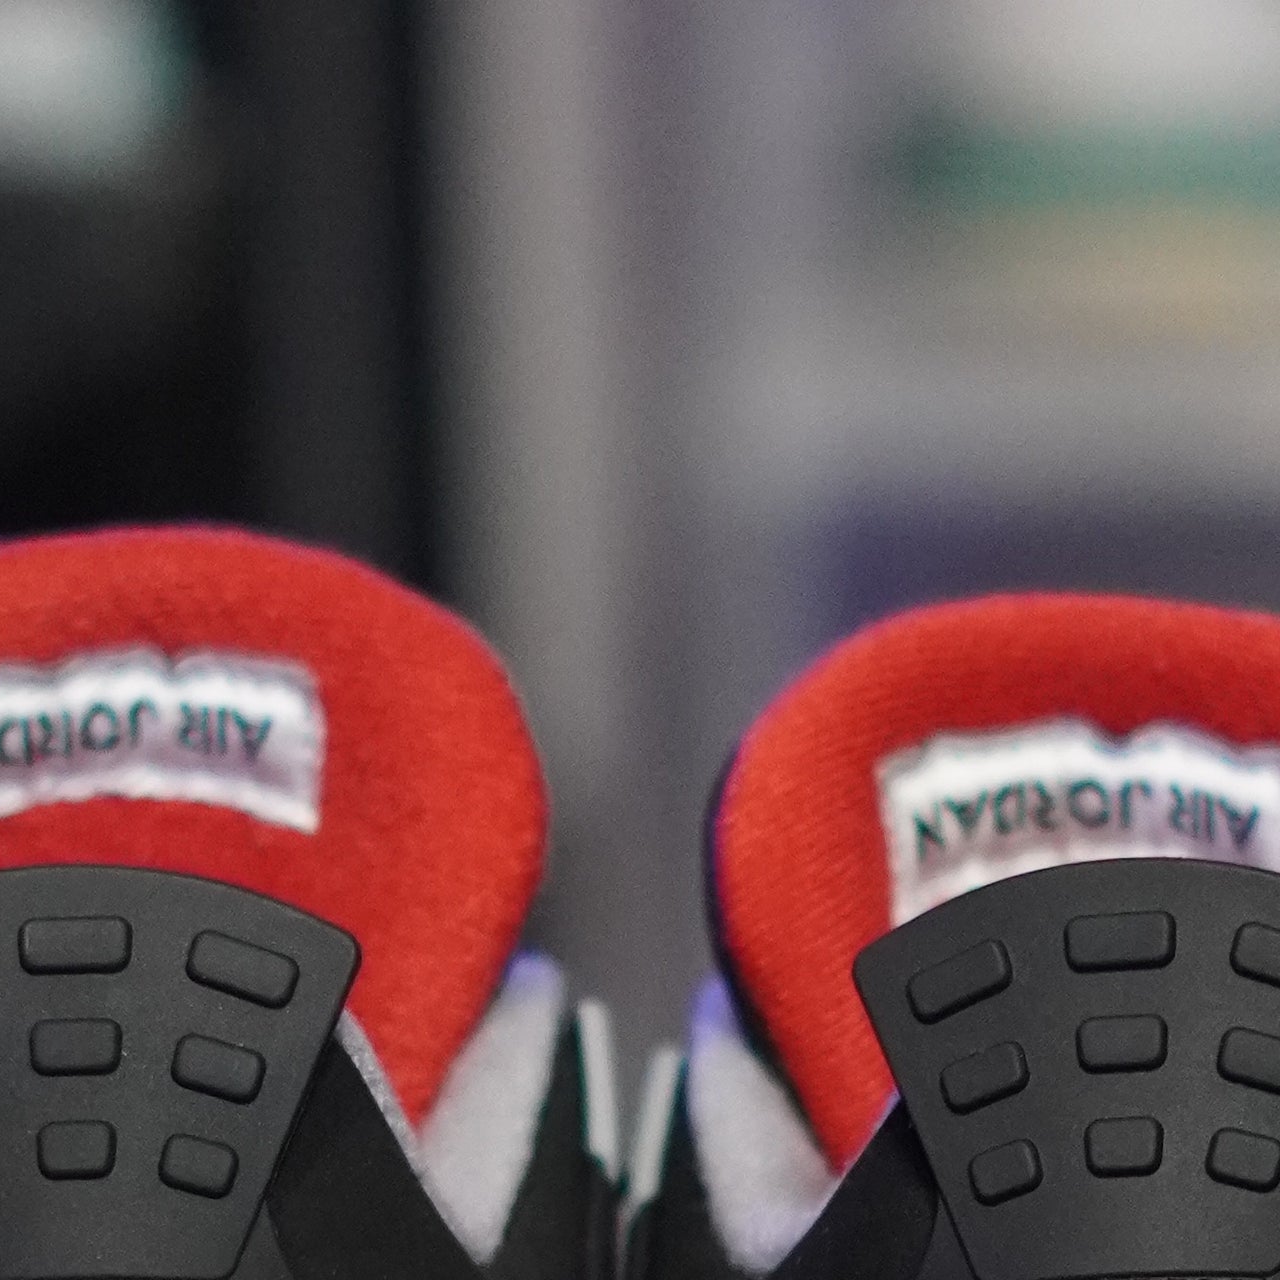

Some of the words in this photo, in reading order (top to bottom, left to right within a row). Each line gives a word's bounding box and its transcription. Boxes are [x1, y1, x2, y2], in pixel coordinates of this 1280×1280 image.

[175, 701, 272, 763] AIR
[912, 776, 1153, 856] JORDAN
[1167, 781, 1260, 848] AIR
